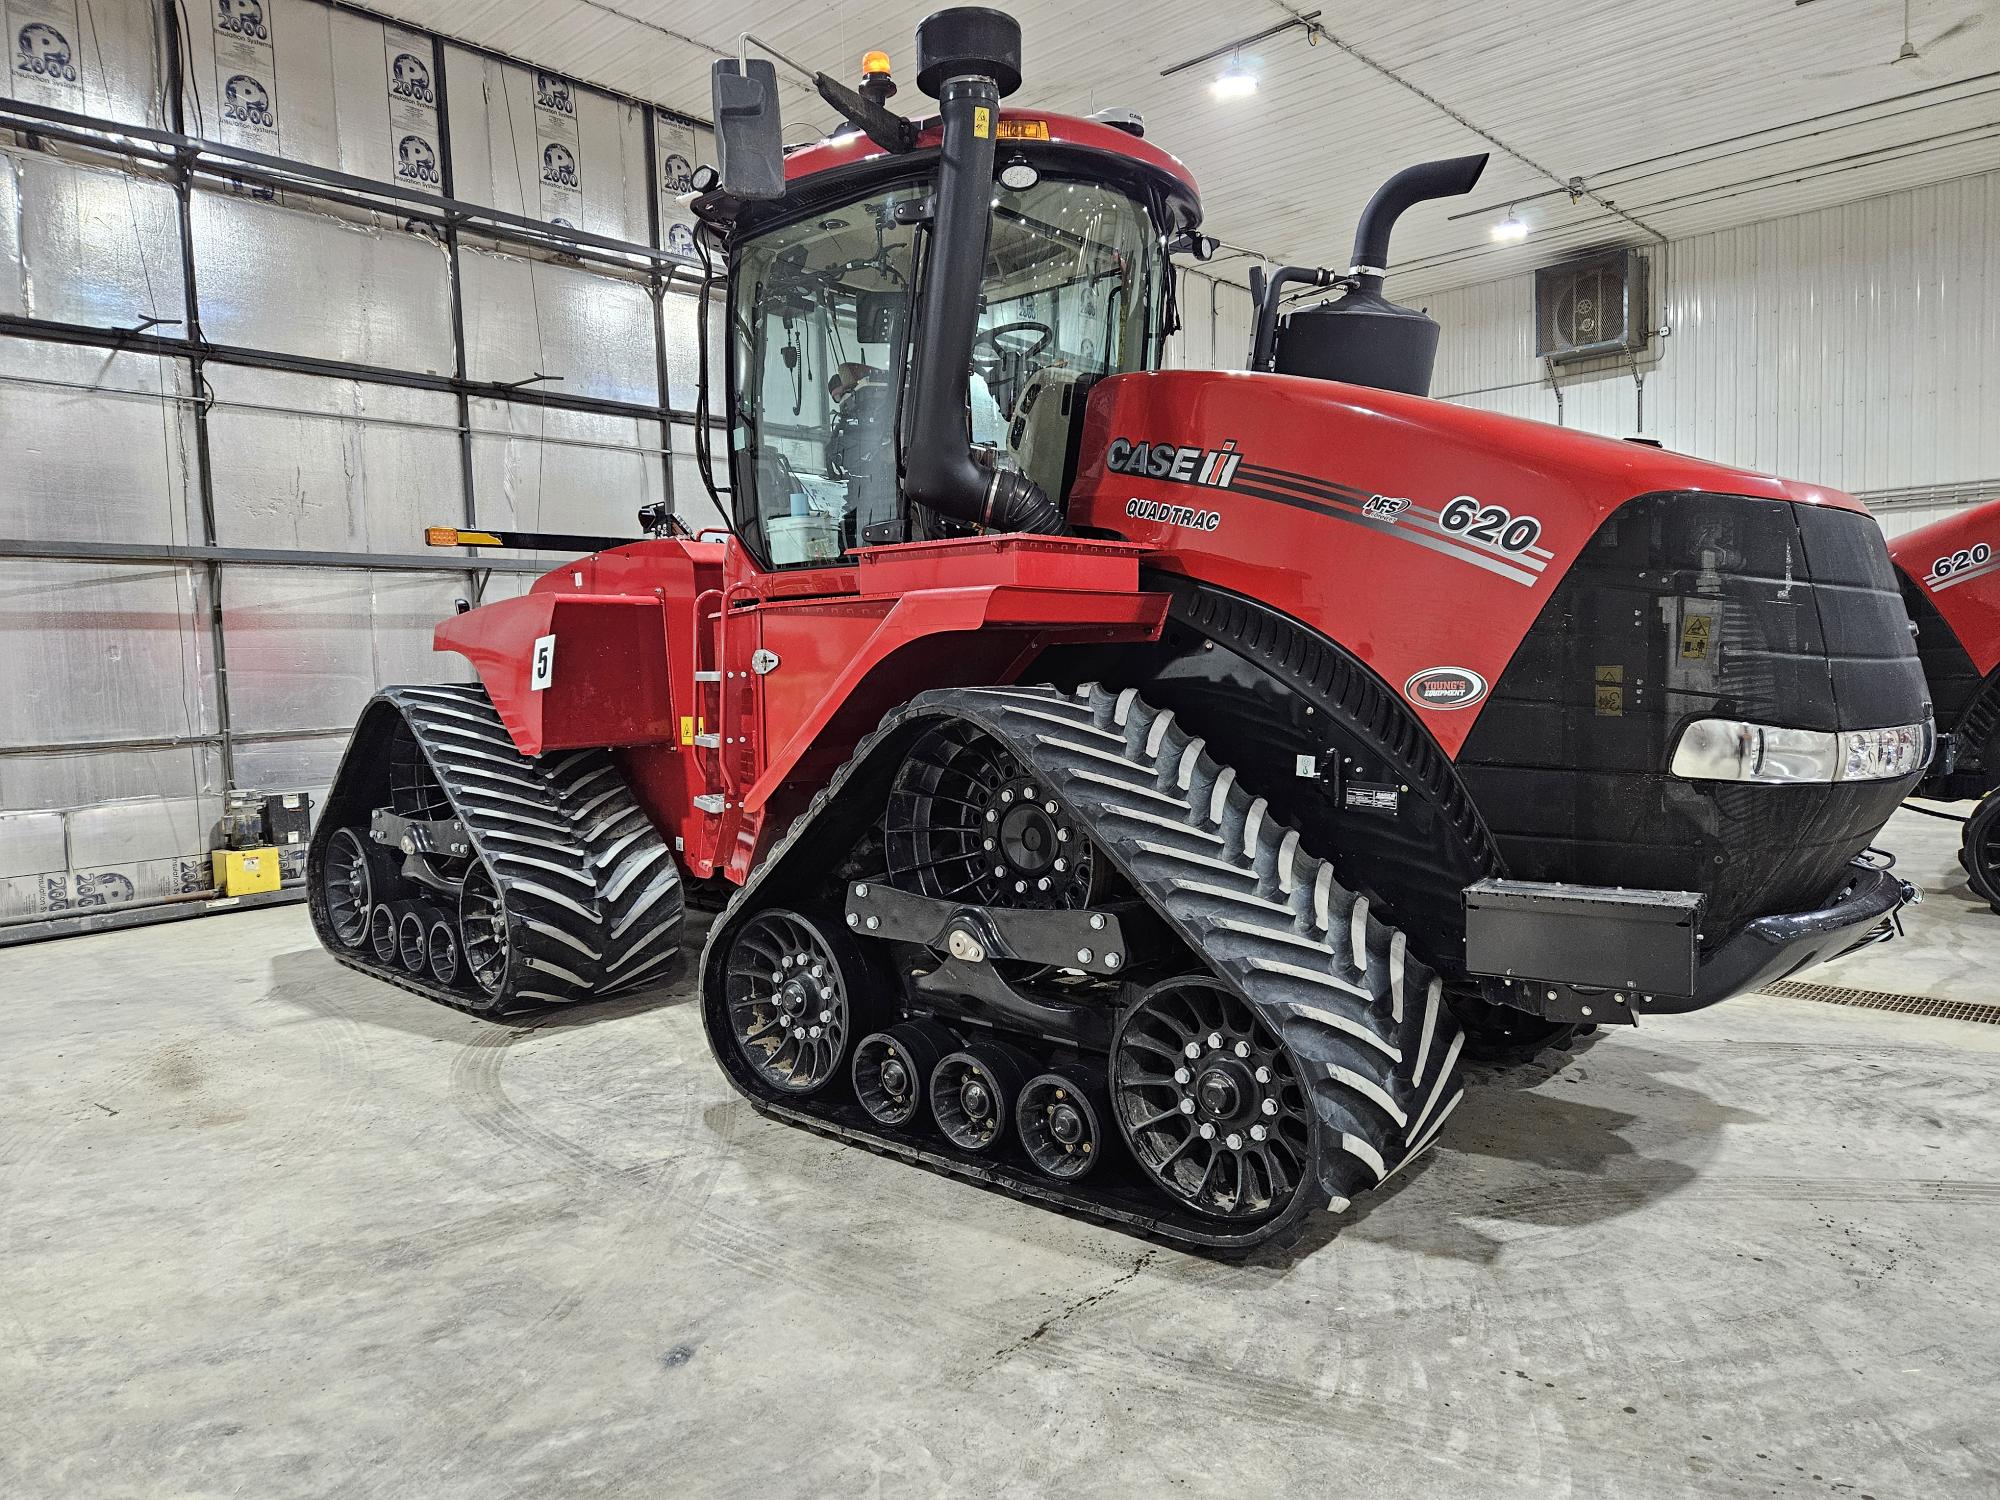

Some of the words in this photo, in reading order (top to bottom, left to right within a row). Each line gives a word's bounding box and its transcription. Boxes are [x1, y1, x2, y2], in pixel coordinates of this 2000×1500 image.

[218, 13, 267, 40] 2000
[17, 51, 76, 82] 2000
[392, 78, 433, 103] 2000
[536, 90, 573, 114] 2000
[224, 102, 274, 128] 2000
[398, 160, 440, 184] 2000
[543, 166, 578, 187] 2000
[1106, 437, 1202, 481] CASE
[1126, 498, 1221, 532] QUADTRAC
[1364, 495, 1402, 514] AFS
[1439, 496, 1541, 554] 620
[1932, 543, 1991, 578] 620
[537, 646, 549, 679] 5
[1424, 681, 1466, 690] YOUNG'S
[1424, 689, 1466, 698] EQUIPMENT
